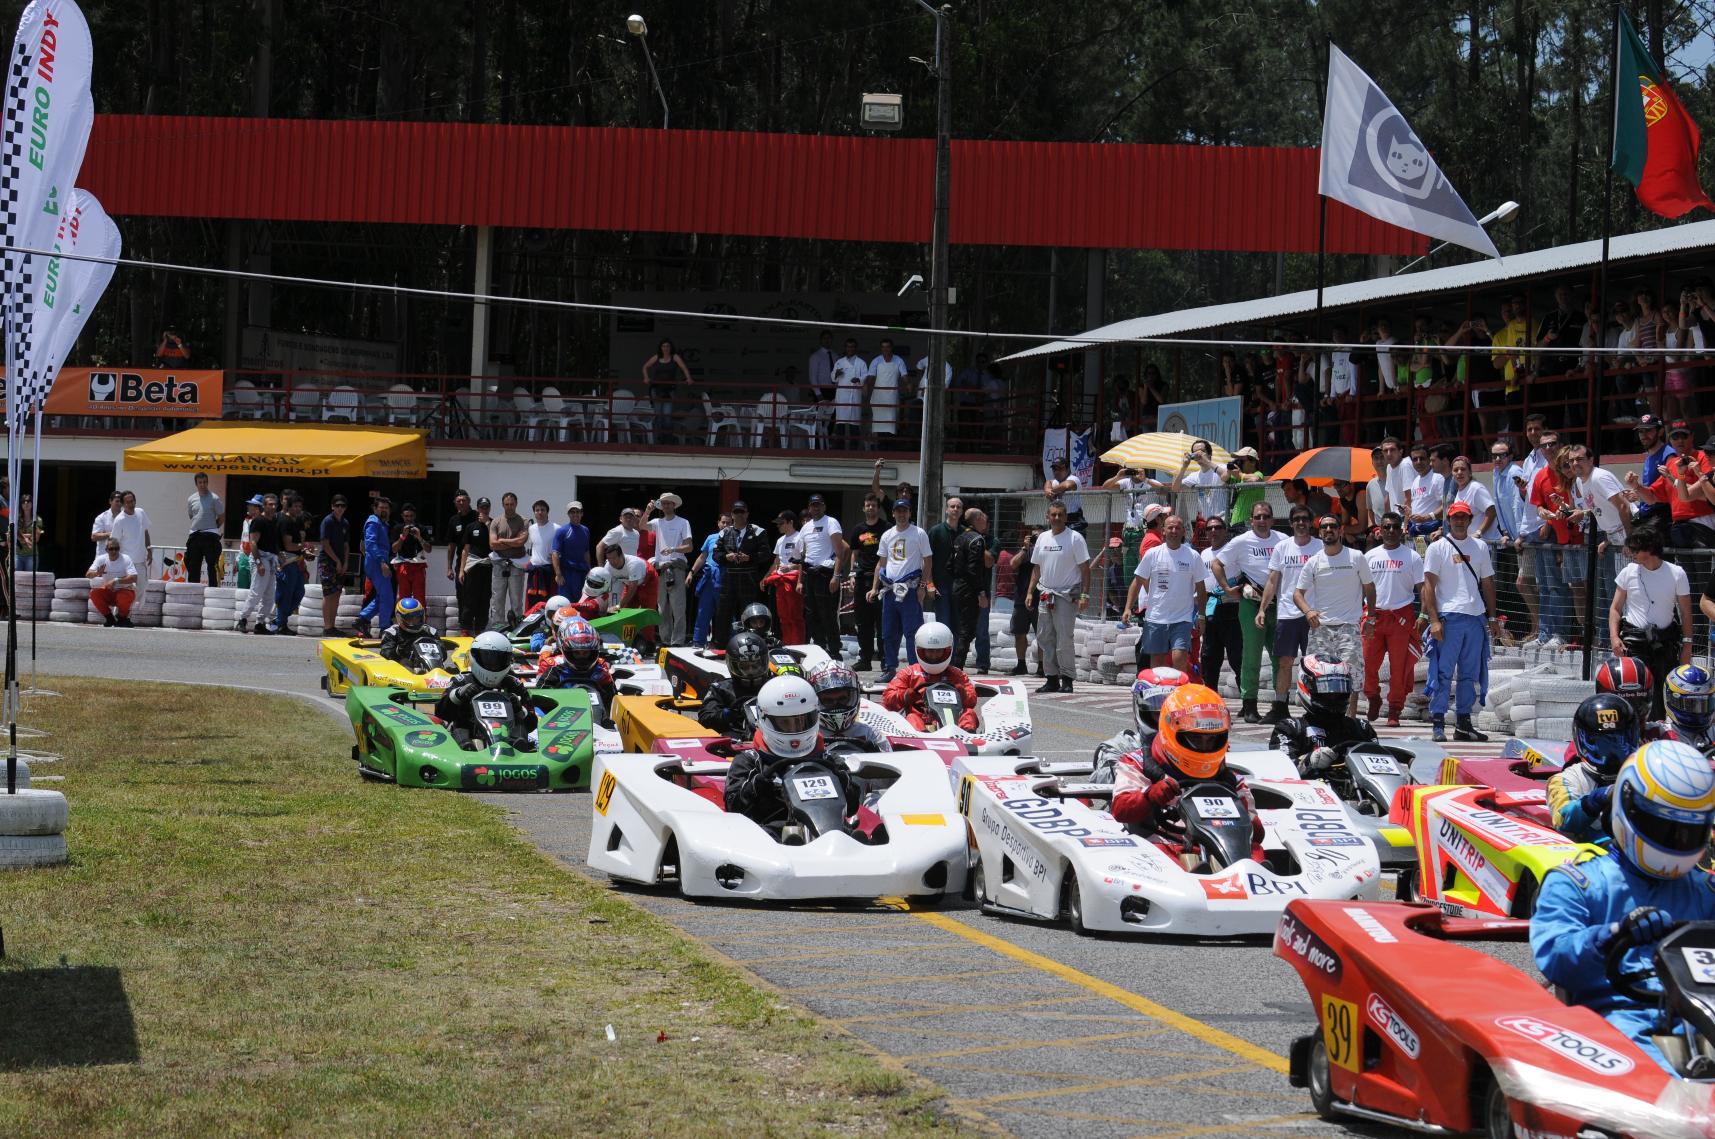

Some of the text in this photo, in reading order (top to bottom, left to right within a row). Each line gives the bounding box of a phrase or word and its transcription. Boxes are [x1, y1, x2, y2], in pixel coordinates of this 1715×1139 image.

[37, 9, 60, 83] INDY
[28, 86, 51, 171] EURO
[119, 372, 199, 404] Beta
[163, 463, 330, 475] www.pestronix.pt
[1371, 560, 1404, 569] UNITRIP
[1599, 710, 1618, 723] tvi
[499, 768, 538, 784] JOGOS
[1368, 757, 1389, 765] 125
[801, 778, 828, 788] 129
[1203, 798, 1225, 806] 90
[1221, 819, 1235, 827] BPI
[1469, 811, 1561, 846] UNITRIP
[982, 808, 1047, 883] Grupo Desportivo BPI
[1439, 819, 1485, 872] UNITRIP
[1247, 873, 1309, 895] BPI
[1281, 914, 1336, 974] Tools and more
[1328, 1002, 1352, 1065] 39
[1369, 998, 1418, 1052] KS TOOLS
[1503, 1018, 1623, 1070] KS TOOLS
